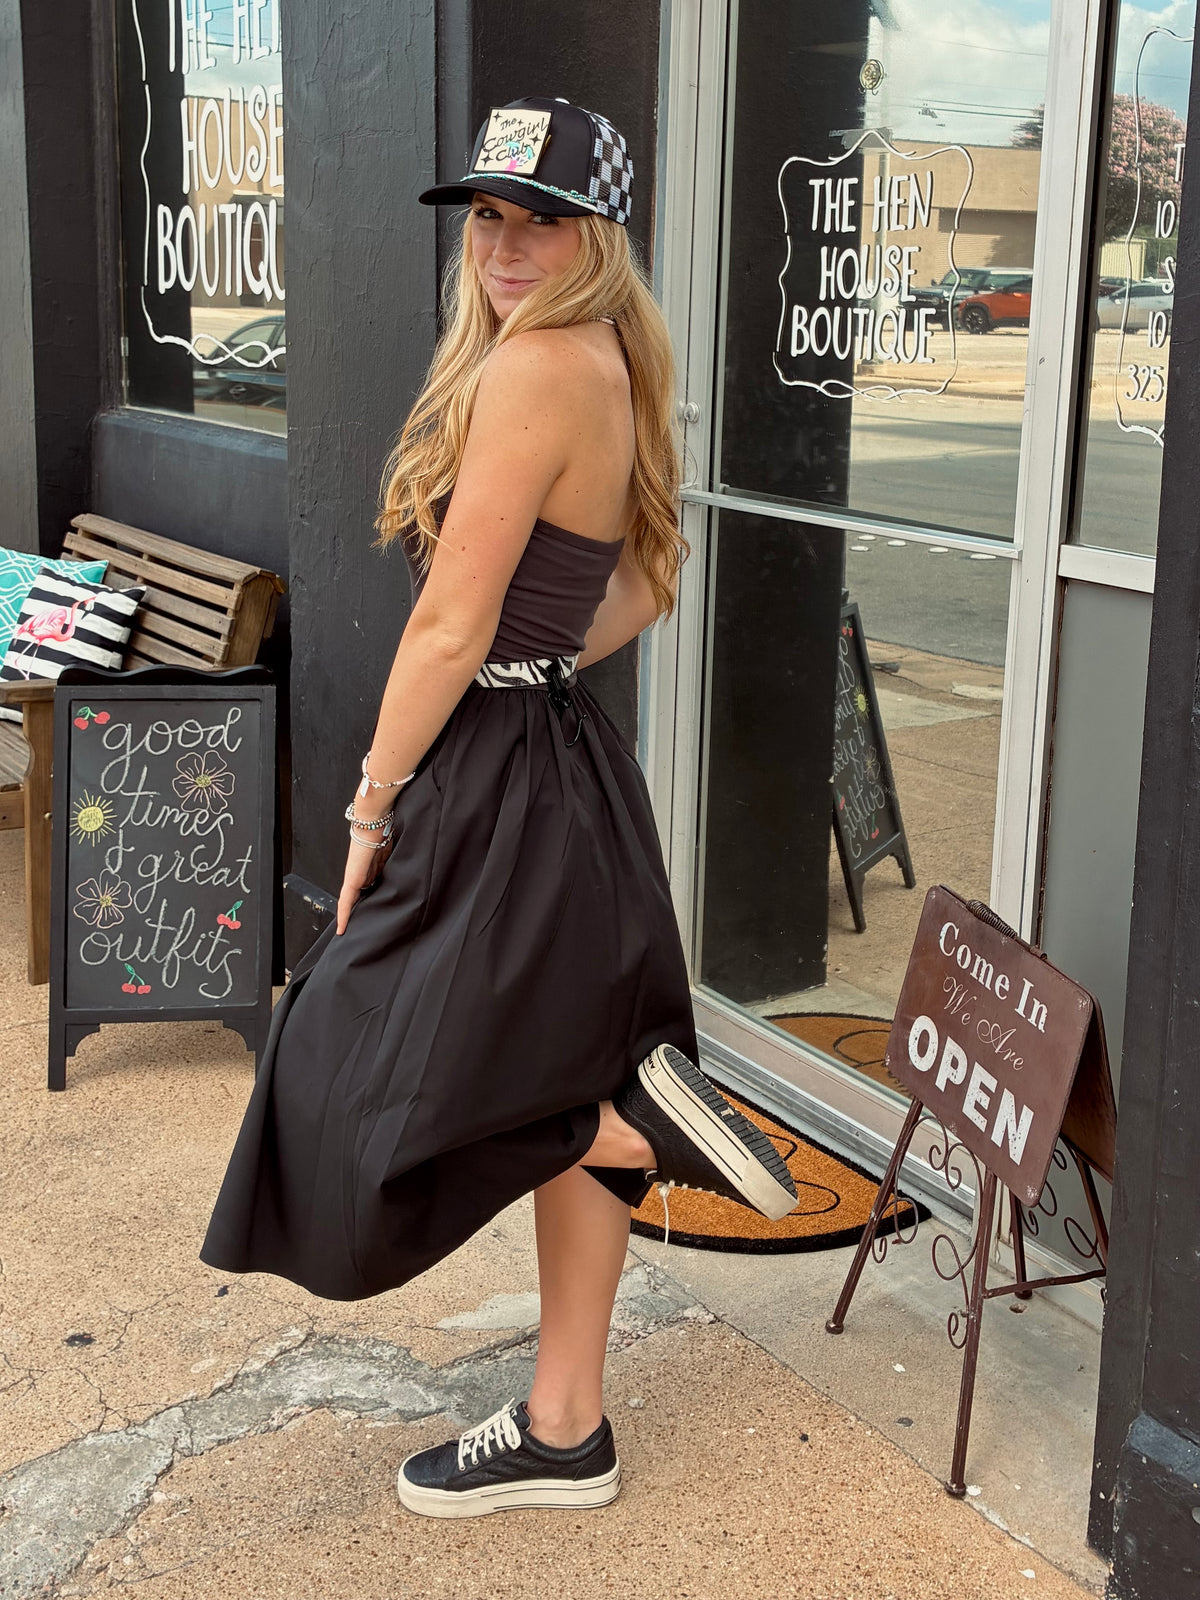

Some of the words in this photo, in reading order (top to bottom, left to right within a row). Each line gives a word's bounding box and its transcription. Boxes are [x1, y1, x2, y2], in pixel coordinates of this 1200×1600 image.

[181, 84, 284, 195] HOUSE
[481, 117, 549, 153] Cowgirl
[495, 142, 530, 161] Club
[500, 117, 518, 131] The
[809, 177, 858, 234] THE
[872, 171, 933, 233] HEN
[157, 199, 286, 302] BOUTIQU
[819, 244, 920, 303] HOUSE
[790, 304, 936, 364] BOUTIQUE
[101, 707, 243, 794] good
[120, 765, 234, 871] times
[133, 846, 253, 914] great
[80, 898, 242, 998] outfits
[938, 921, 1011, 1000] Come
[1014, 977, 1050, 1034] In
[943, 976, 977, 1025] We
[976, 1018, 1025, 1071] Are
[908, 1014, 1035, 1166] OPEN
